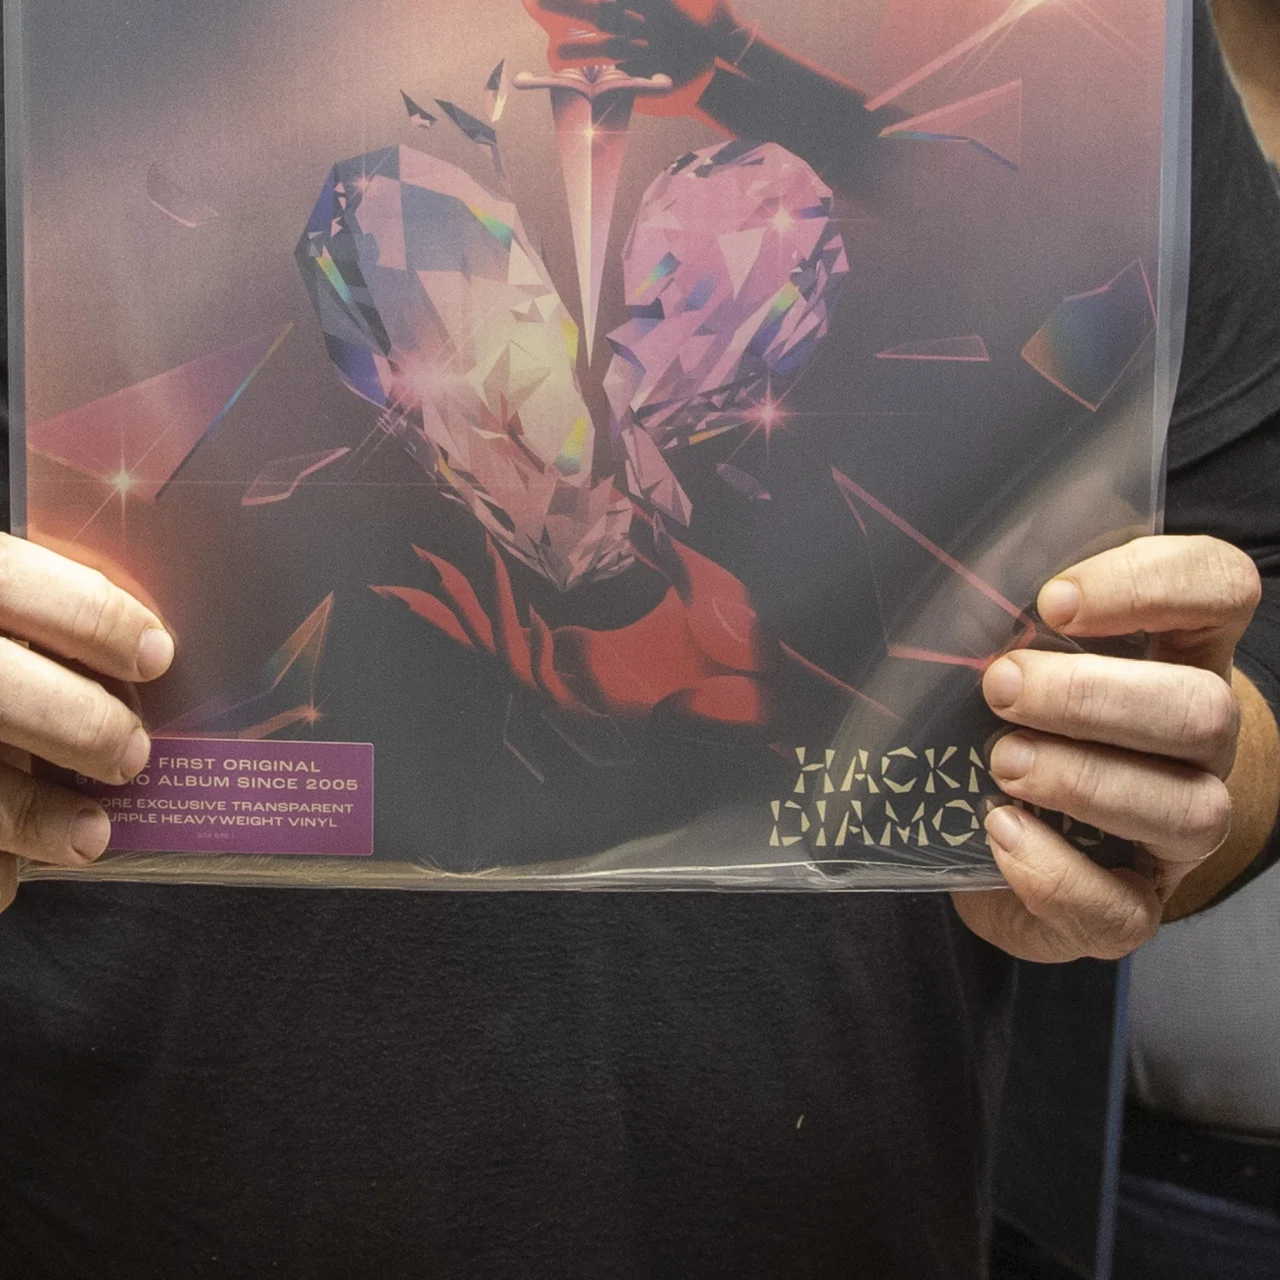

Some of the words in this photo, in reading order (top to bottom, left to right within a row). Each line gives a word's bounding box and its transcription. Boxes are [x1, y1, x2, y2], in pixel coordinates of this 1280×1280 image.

[159, 757, 216, 770] FIRST
[223, 759, 321, 773] ORIGINAL
[158, 775, 230, 789] ALBUM
[237, 777, 298, 790] SINCE
[306, 778, 358, 791] 2005
[97, 797, 133, 809] ORE
[136, 798, 227, 811] EXCLUSIVE
[232, 801, 354, 814] TRANSPARENT
[109, 813, 157, 824] URPLE
[161, 814, 284, 827] HEAVYWEIGHT
[288, 817, 338, 828] VINYL
